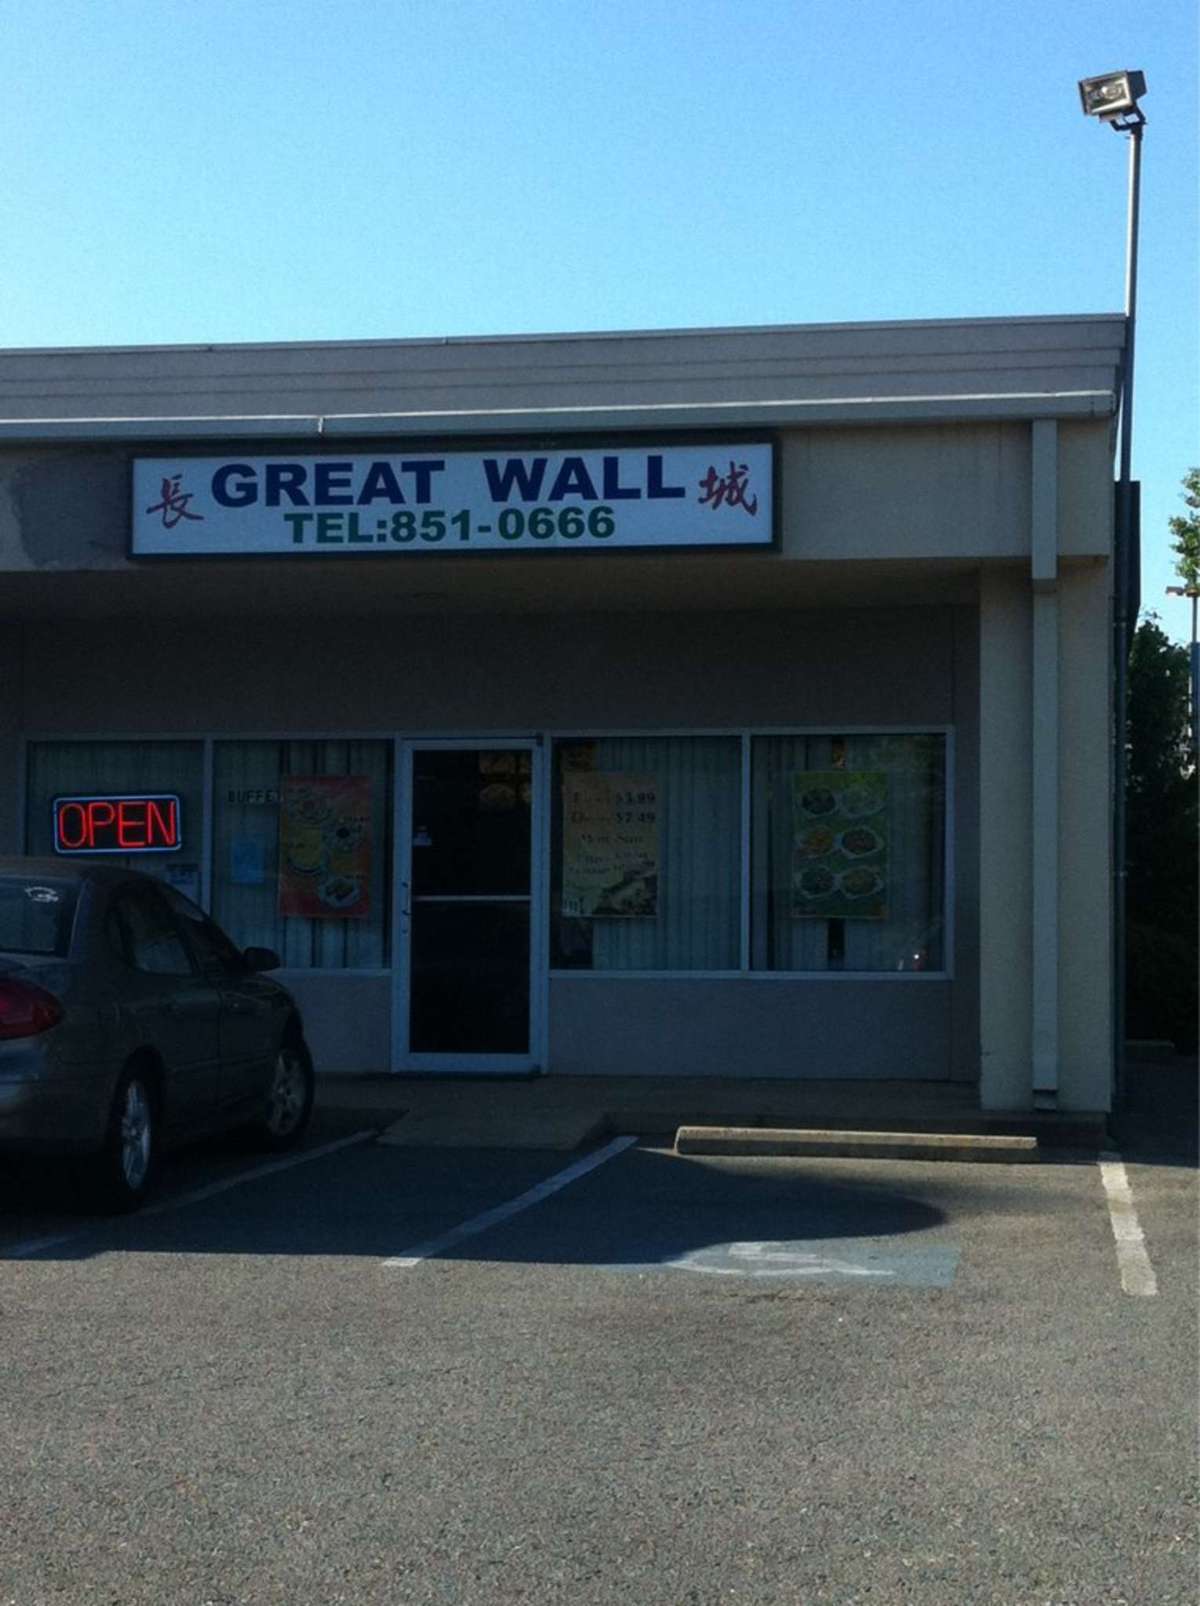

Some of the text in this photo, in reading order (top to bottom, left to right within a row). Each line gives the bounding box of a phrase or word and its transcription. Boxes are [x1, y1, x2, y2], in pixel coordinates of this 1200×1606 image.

[146, 473, 204, 529] 長
[211, 455, 686, 508] GREAT WALL
[697, 460, 758, 517] 城
[284, 505, 615, 544] TEL:851-0666
[58, 801, 177, 848] OPEN
